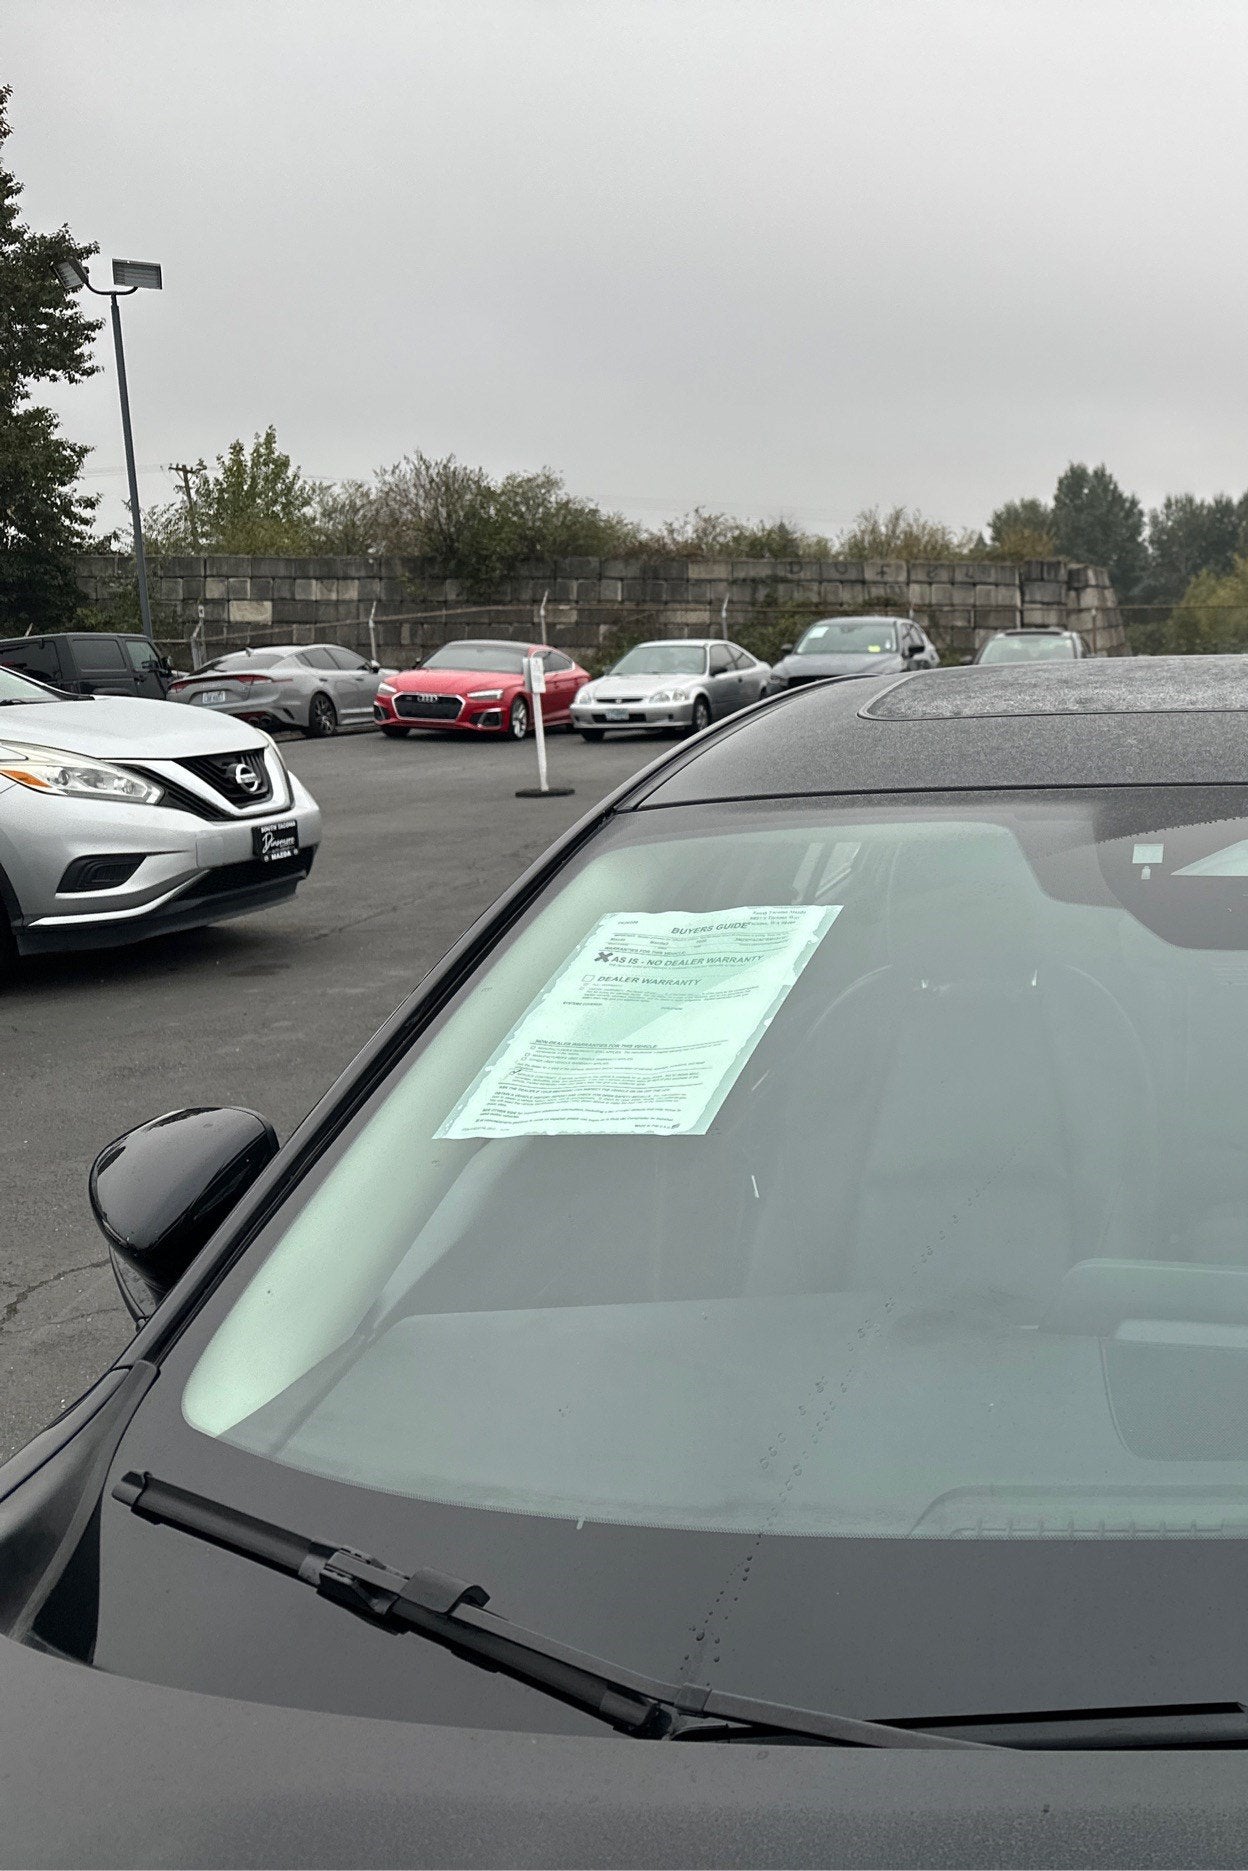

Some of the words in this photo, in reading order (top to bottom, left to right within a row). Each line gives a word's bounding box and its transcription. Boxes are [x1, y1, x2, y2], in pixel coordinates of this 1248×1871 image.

[671, 926, 713, 935] BUYERS
[716, 922, 749, 931] GUIDE
[611, 956, 627, 964] AS
[628, 957, 639, 965] IS
[647, 958, 663, 966] NO
[664, 957, 704, 967] DEALER
[706, 955, 765, 965] WARRANTY
[641, 977, 702, 987] WARRANTY
